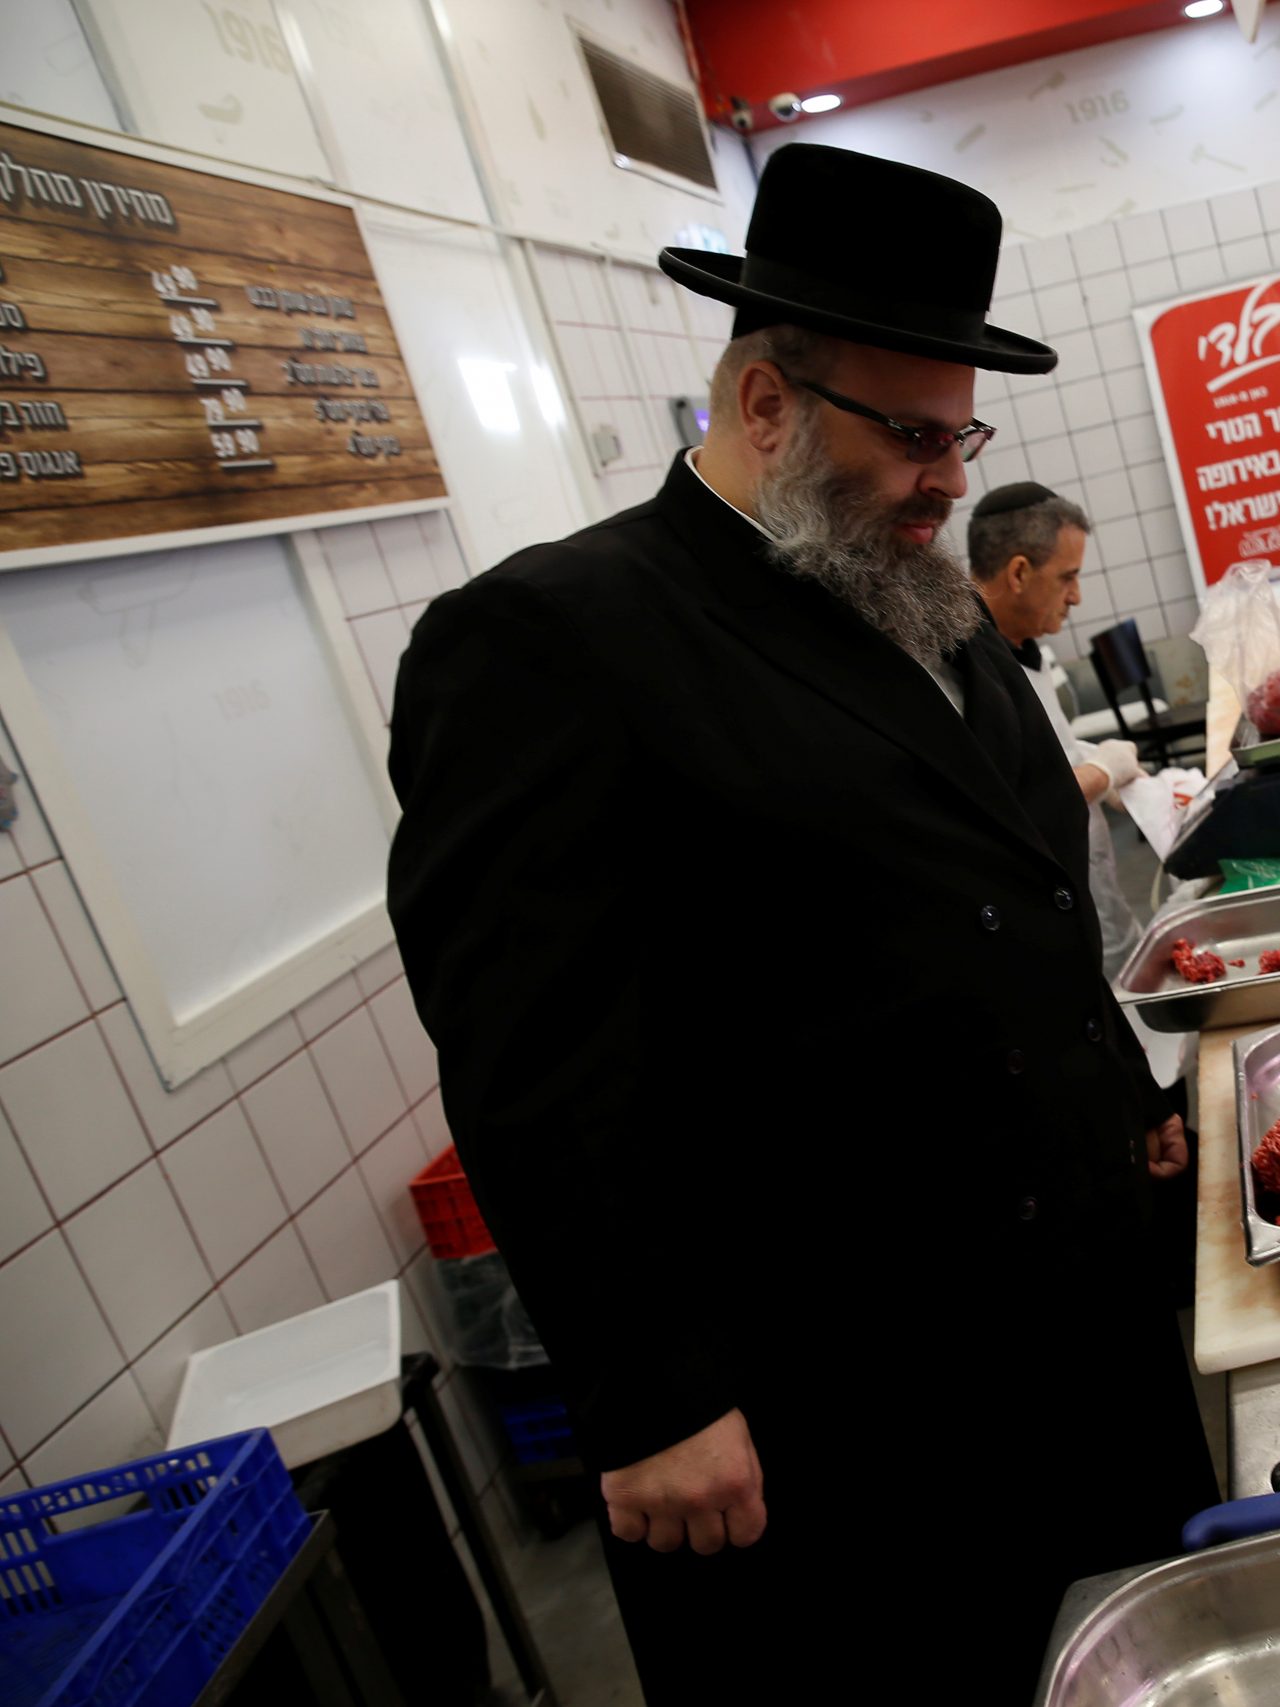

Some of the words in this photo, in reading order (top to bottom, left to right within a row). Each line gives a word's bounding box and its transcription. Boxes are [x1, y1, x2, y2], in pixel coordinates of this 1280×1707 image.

[1065, 88, 1130, 124] 1916
[79, 178, 175, 225] מחירון
[1205, 412, 1263, 445] הטרי
[18, 449, 81, 475] אנגוס
